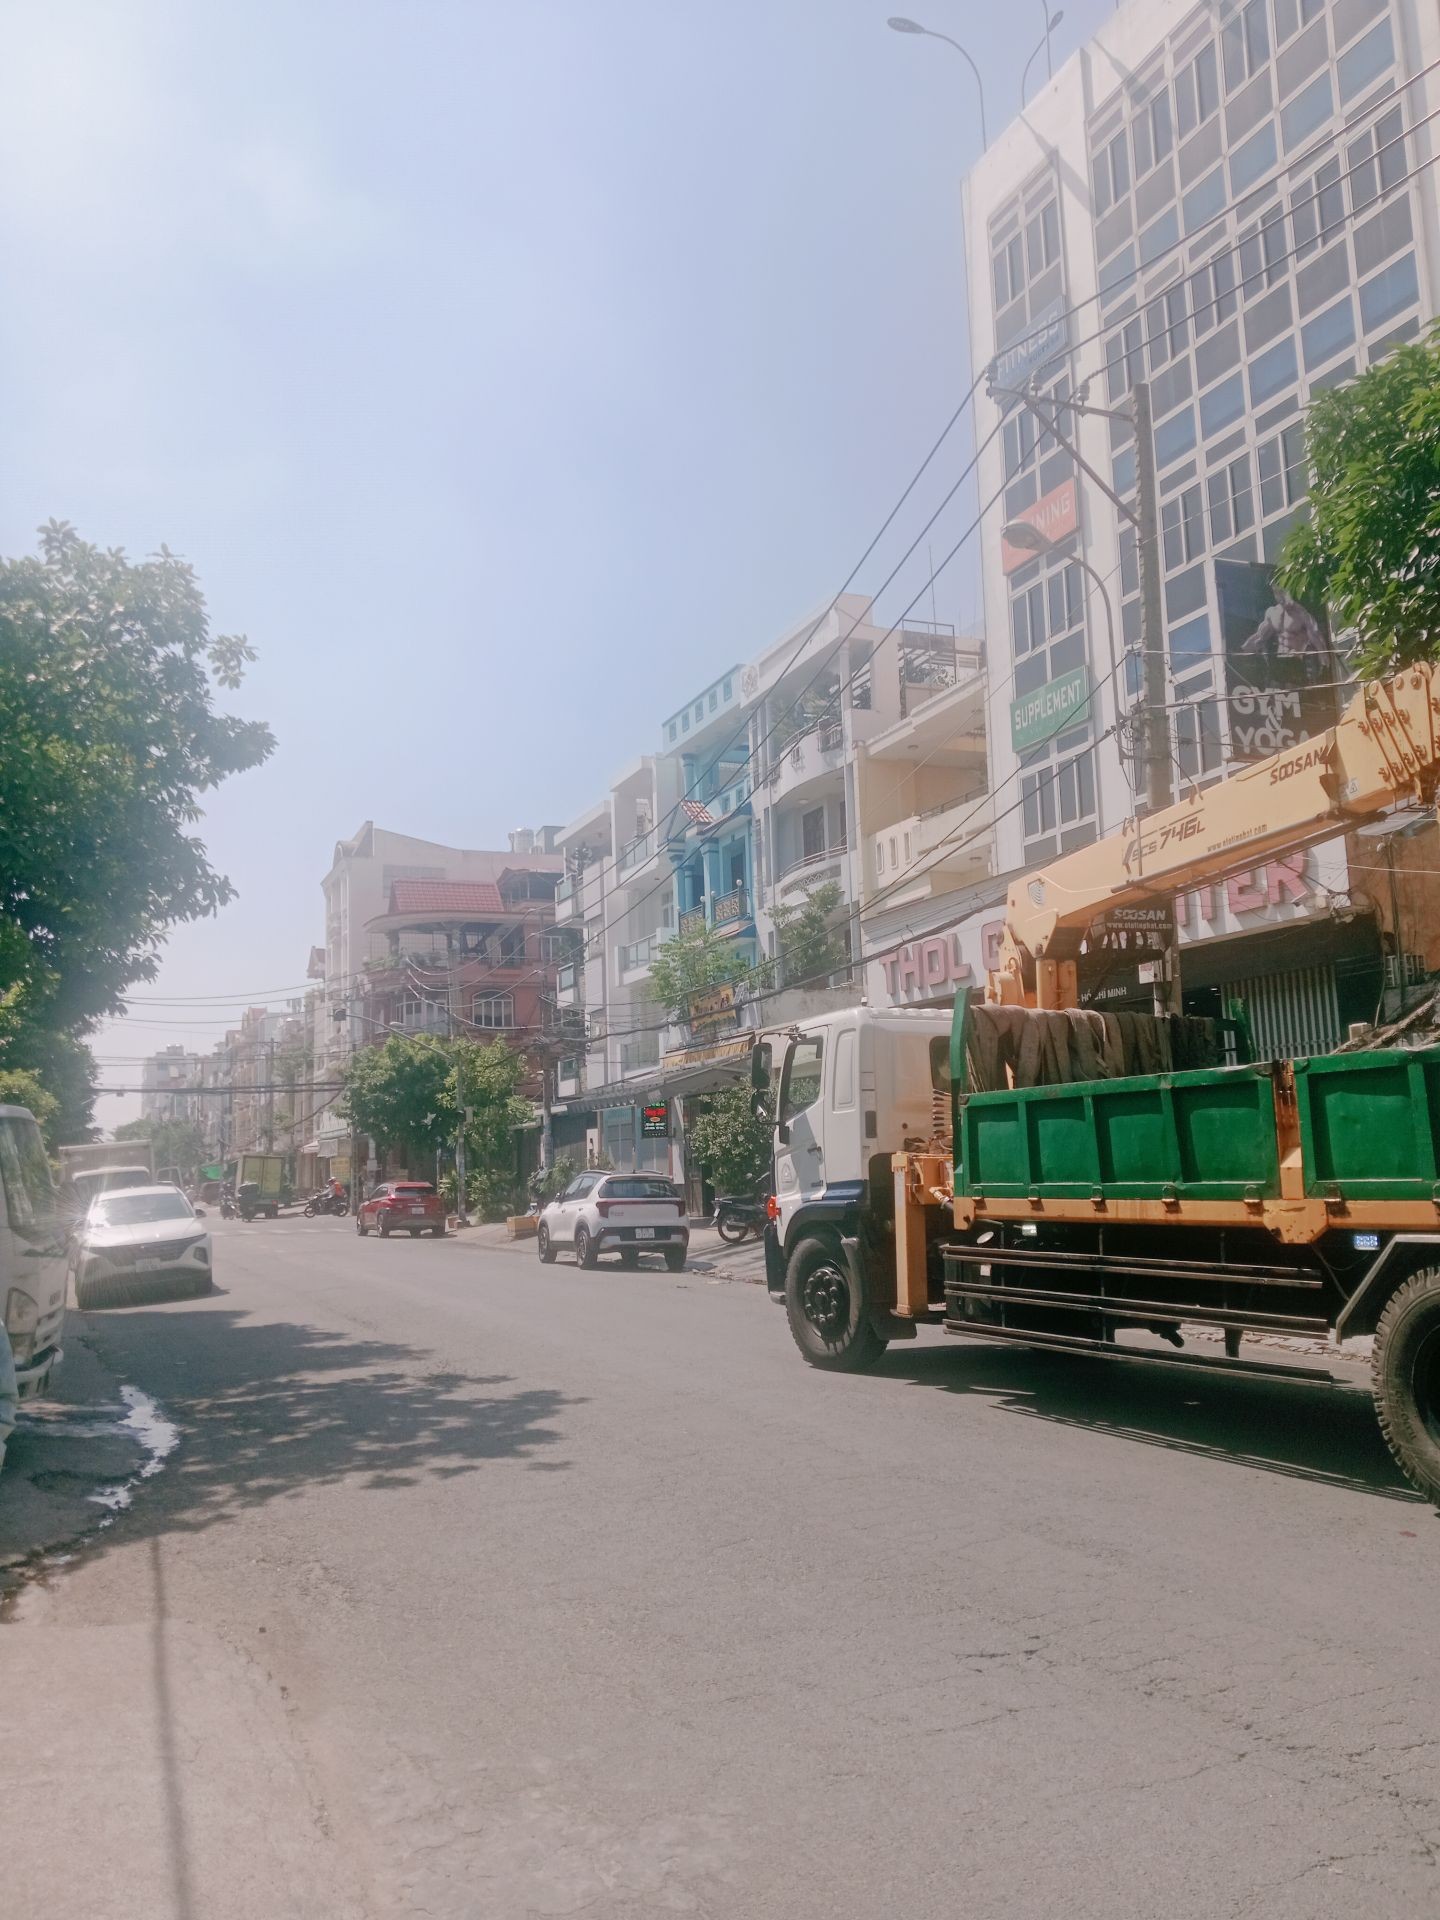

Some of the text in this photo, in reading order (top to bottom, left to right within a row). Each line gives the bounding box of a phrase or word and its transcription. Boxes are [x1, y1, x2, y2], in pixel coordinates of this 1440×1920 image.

[996, 310, 1059, 382] FITNESS
[1031, 493, 1071, 532] INING
[1014, 679, 1081, 731] SUPPLEMENT
[1231, 684, 1302, 718] GYM
[1269, 746, 1326, 786] SOOSAN
[1113, 909, 1166, 920] SOOSAN
[879, 934, 972, 995] THOL
[1107, 986, 1127, 998] MINH
